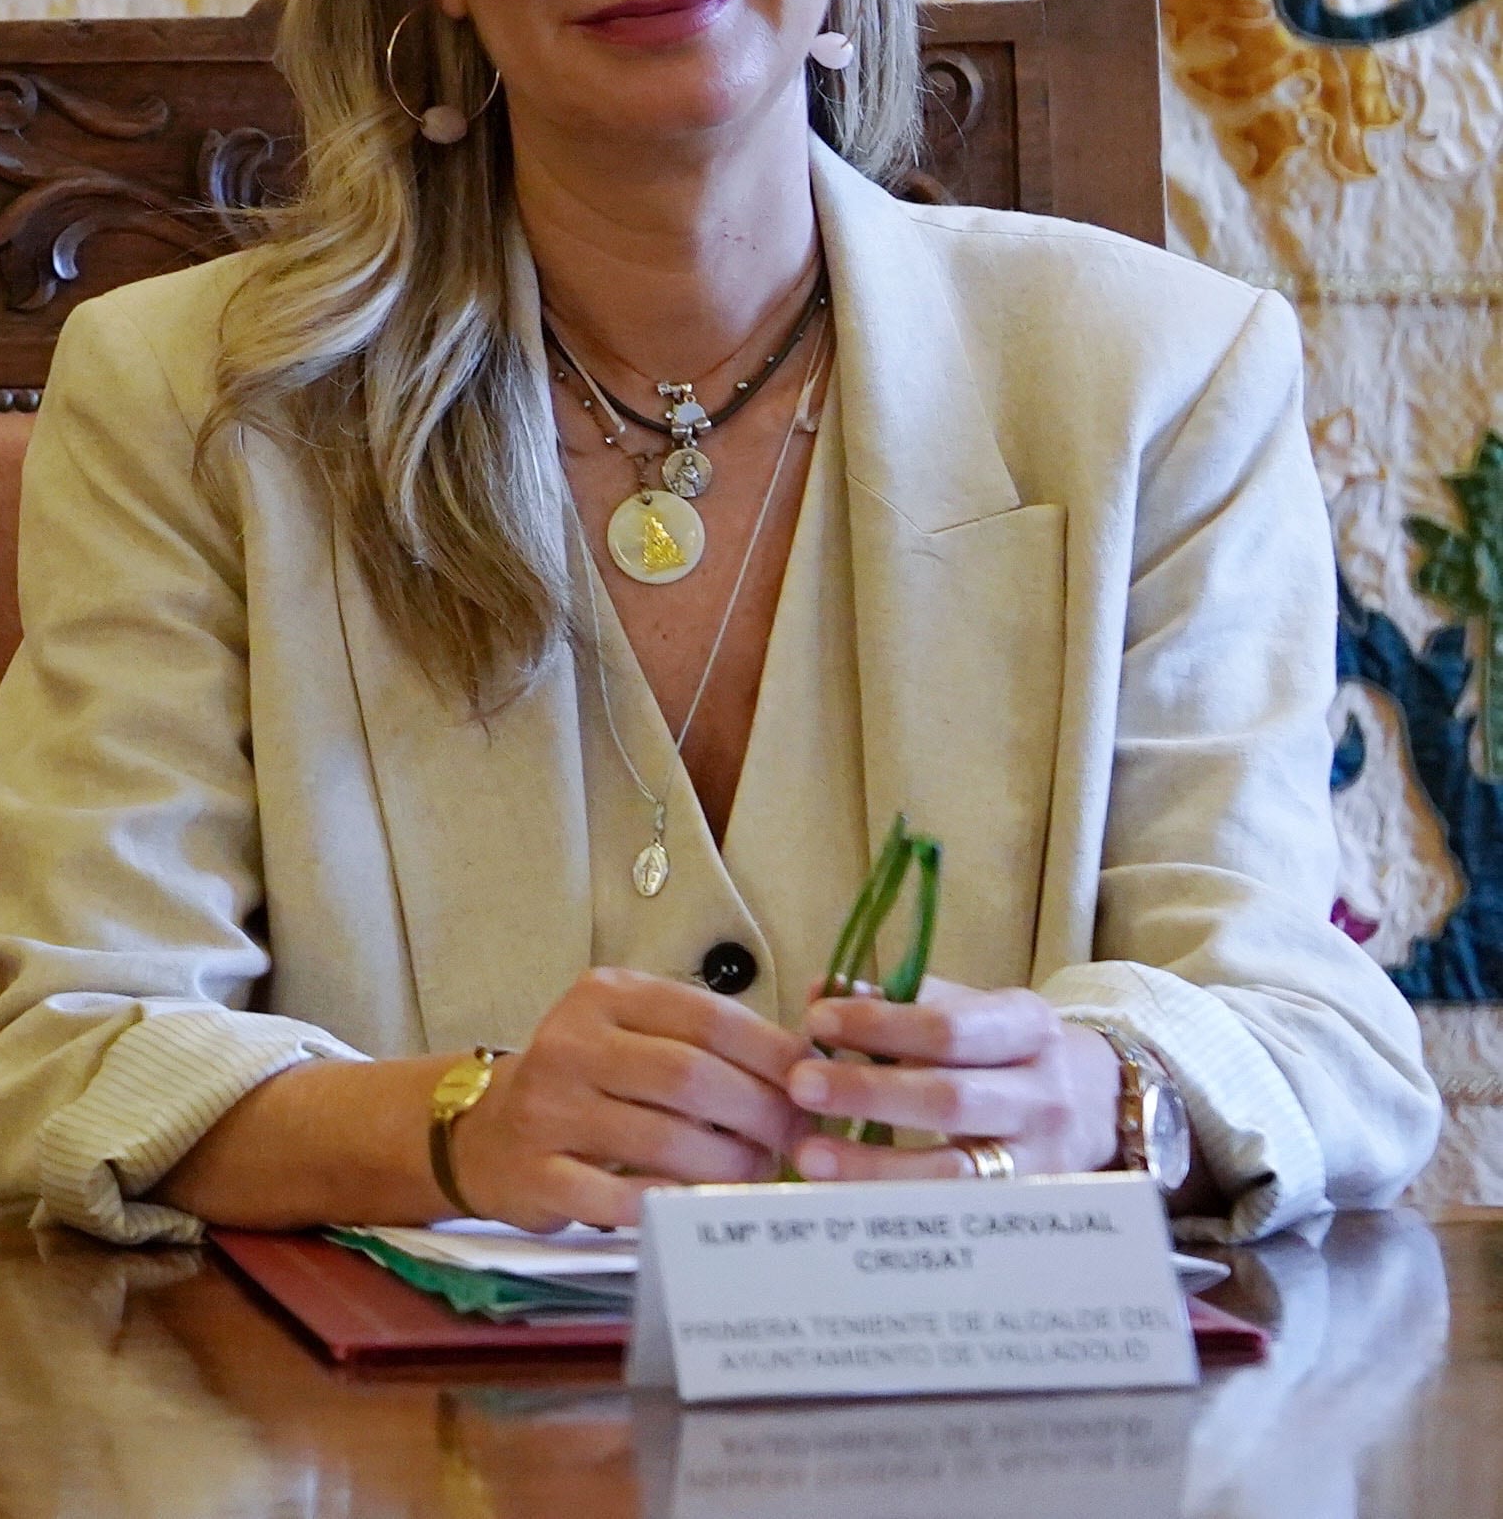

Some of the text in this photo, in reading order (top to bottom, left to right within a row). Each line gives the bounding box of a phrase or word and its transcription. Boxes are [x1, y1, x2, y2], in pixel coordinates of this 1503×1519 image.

[863, 1214, 950, 1240] IRENE
[961, 1210, 1118, 1237] CARVAJAL
[853, 1247, 974, 1273] CRUSAT
[809, 1312, 940, 1338] TENIENTE
[948, 1310, 983, 1334] DE
[995, 1307, 1109, 1332] ALCALDE
[937, 1341, 972, 1367] DE
[981, 1337, 1150, 1366] VALLADOLID
